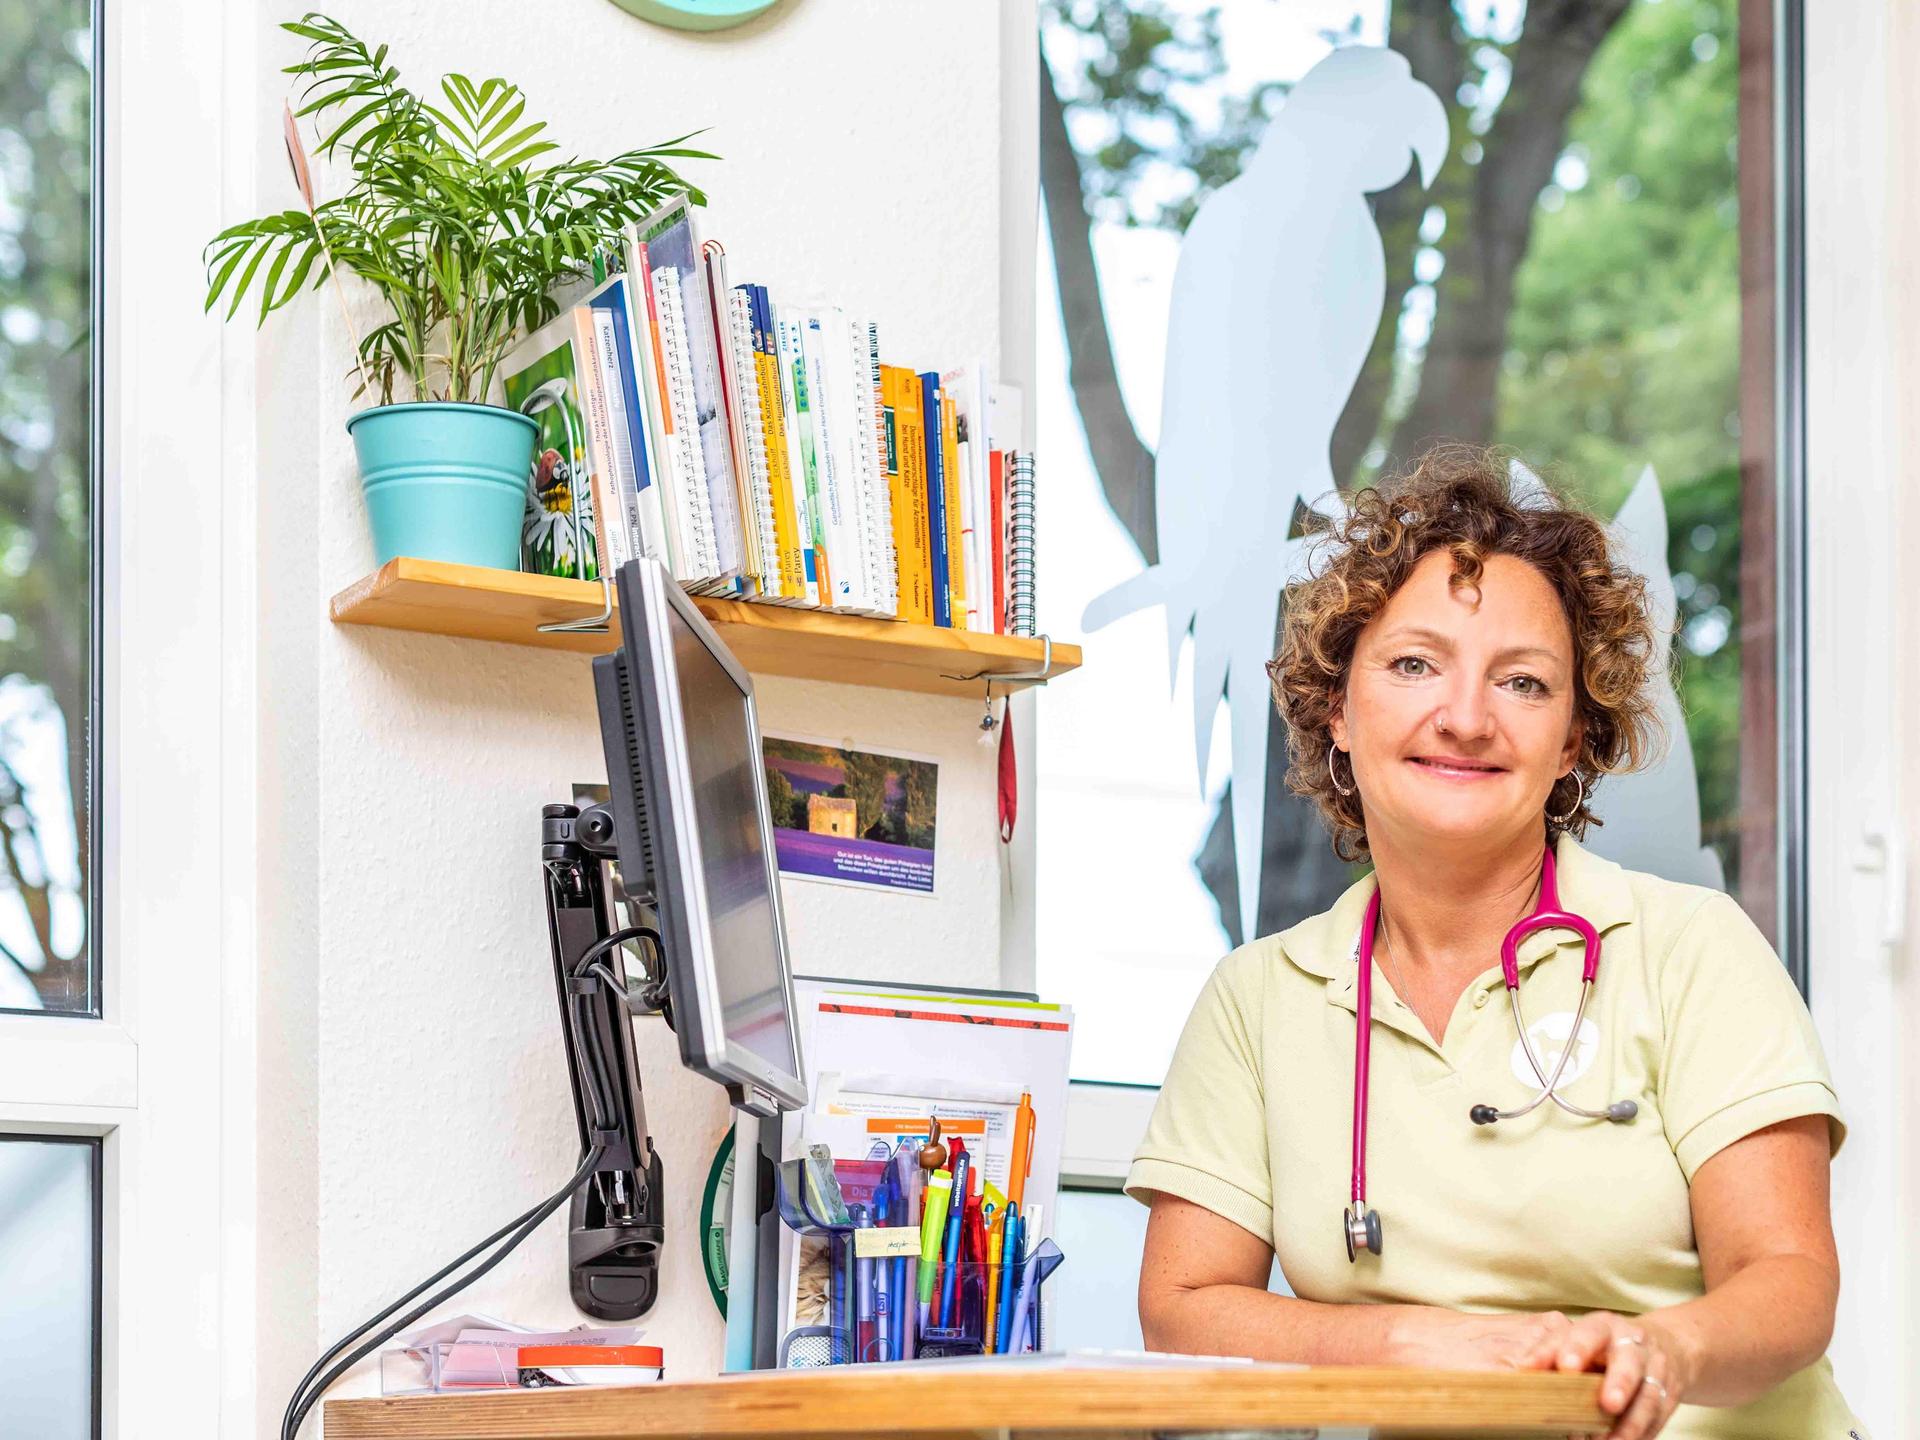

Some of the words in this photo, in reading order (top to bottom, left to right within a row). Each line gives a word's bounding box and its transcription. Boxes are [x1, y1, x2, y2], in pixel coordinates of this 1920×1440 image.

[604, 326, 614, 368] Katzenherz
[760, 358, 771, 419] Katzenzahnbuch
[771, 361, 782, 420] Hundezahnbuch
[910, 425, 918, 496] Dosierungsvorschläge
